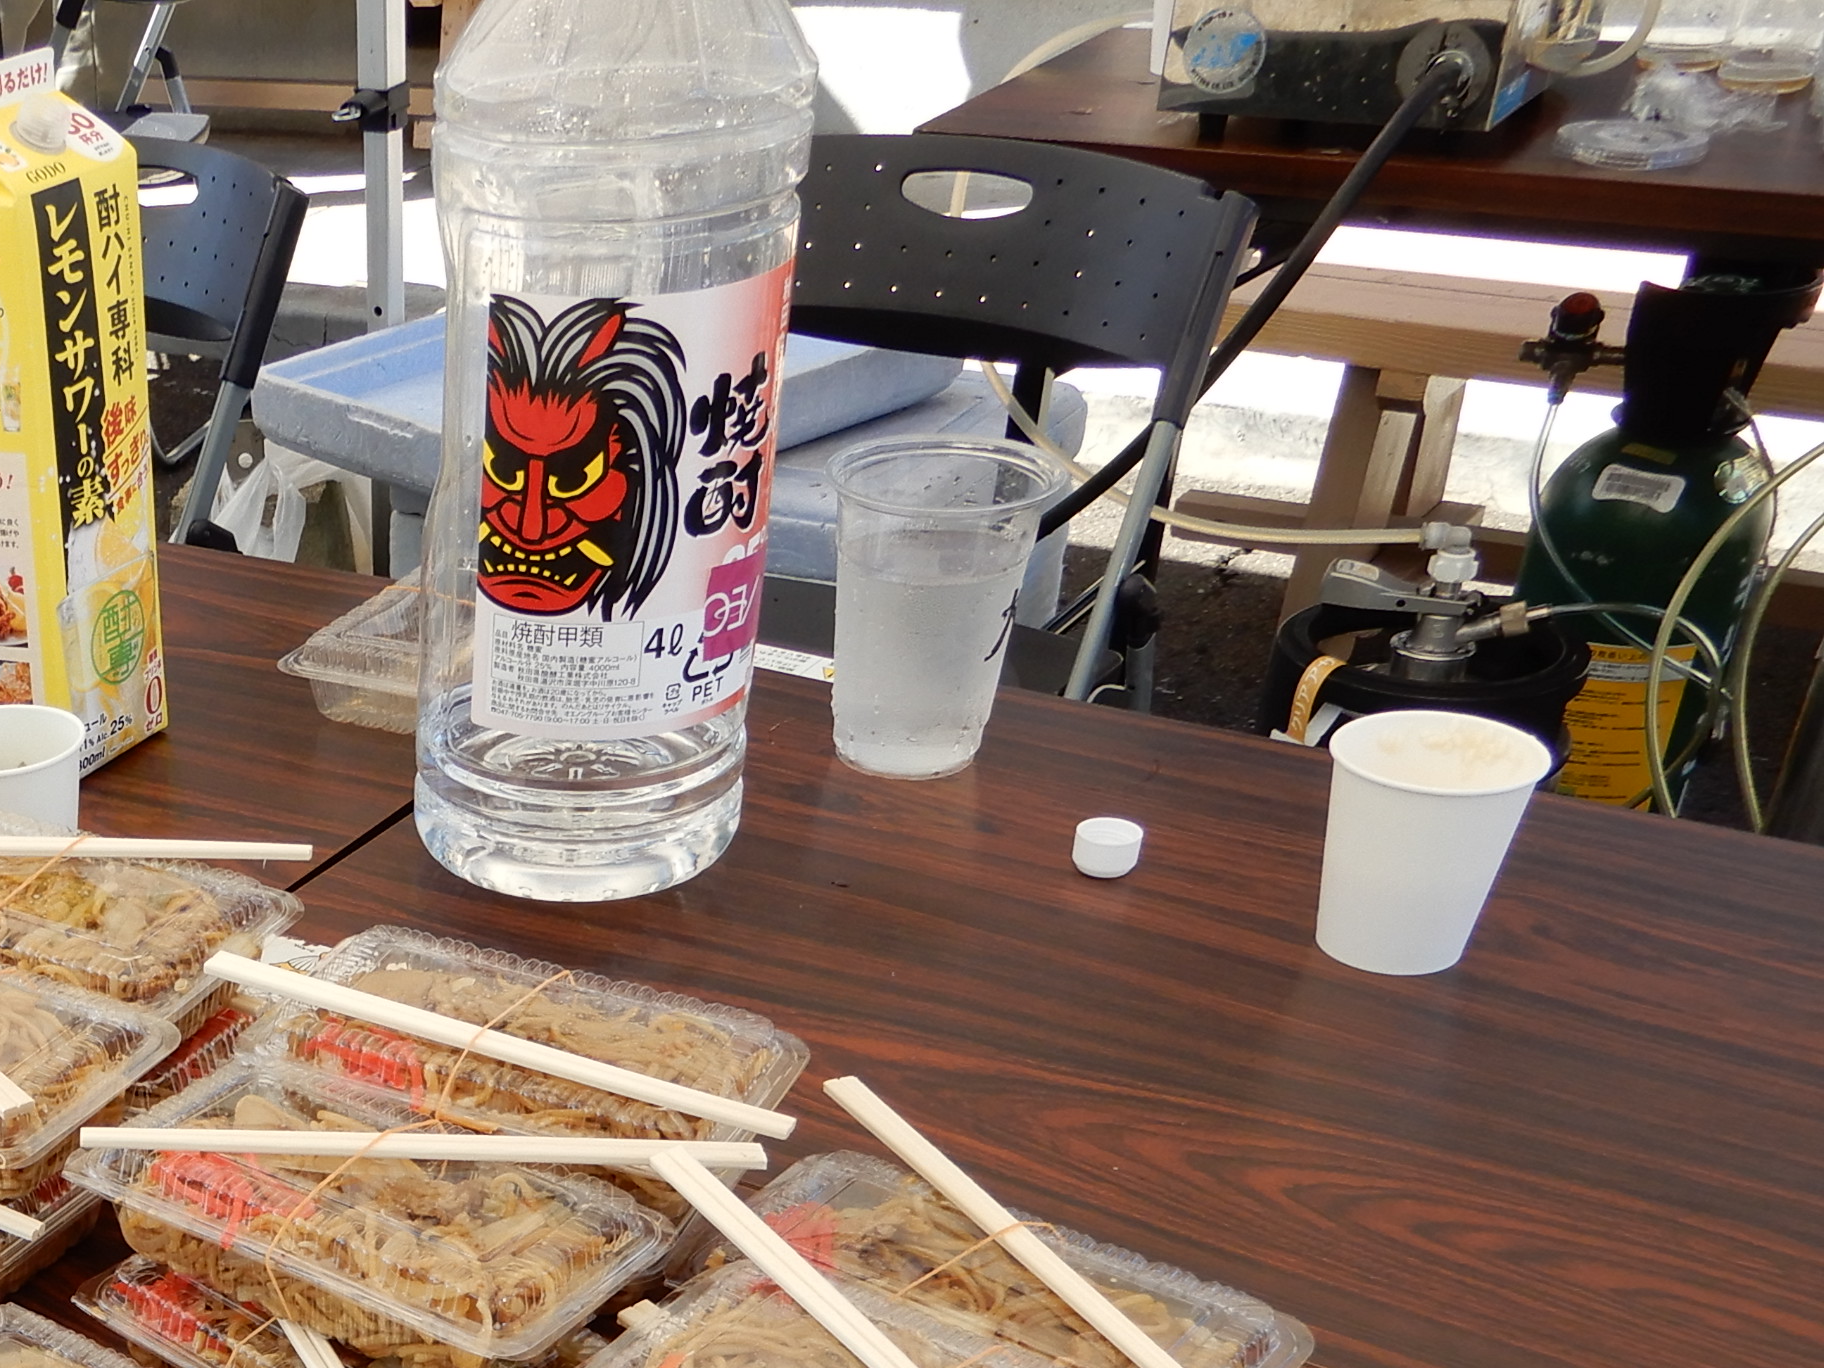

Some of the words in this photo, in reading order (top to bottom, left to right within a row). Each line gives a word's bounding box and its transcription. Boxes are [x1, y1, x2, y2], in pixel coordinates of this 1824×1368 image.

[25, 161, 68, 184] GODO
[93, 182, 135, 388] 酎ハイ専科
[43, 200, 106, 529] レモンサワーの素
[103, 394, 137, 450] 後味
[683, 350, 773, 538] 焼酎
[511, 619, 604, 648] 焼酎甲類
[588, 663, 620, 672] 4000ml
[145, 675, 163, 715] 0
[691, 676, 724, 702] PET
[145, 712, 163, 733] ゼロ
